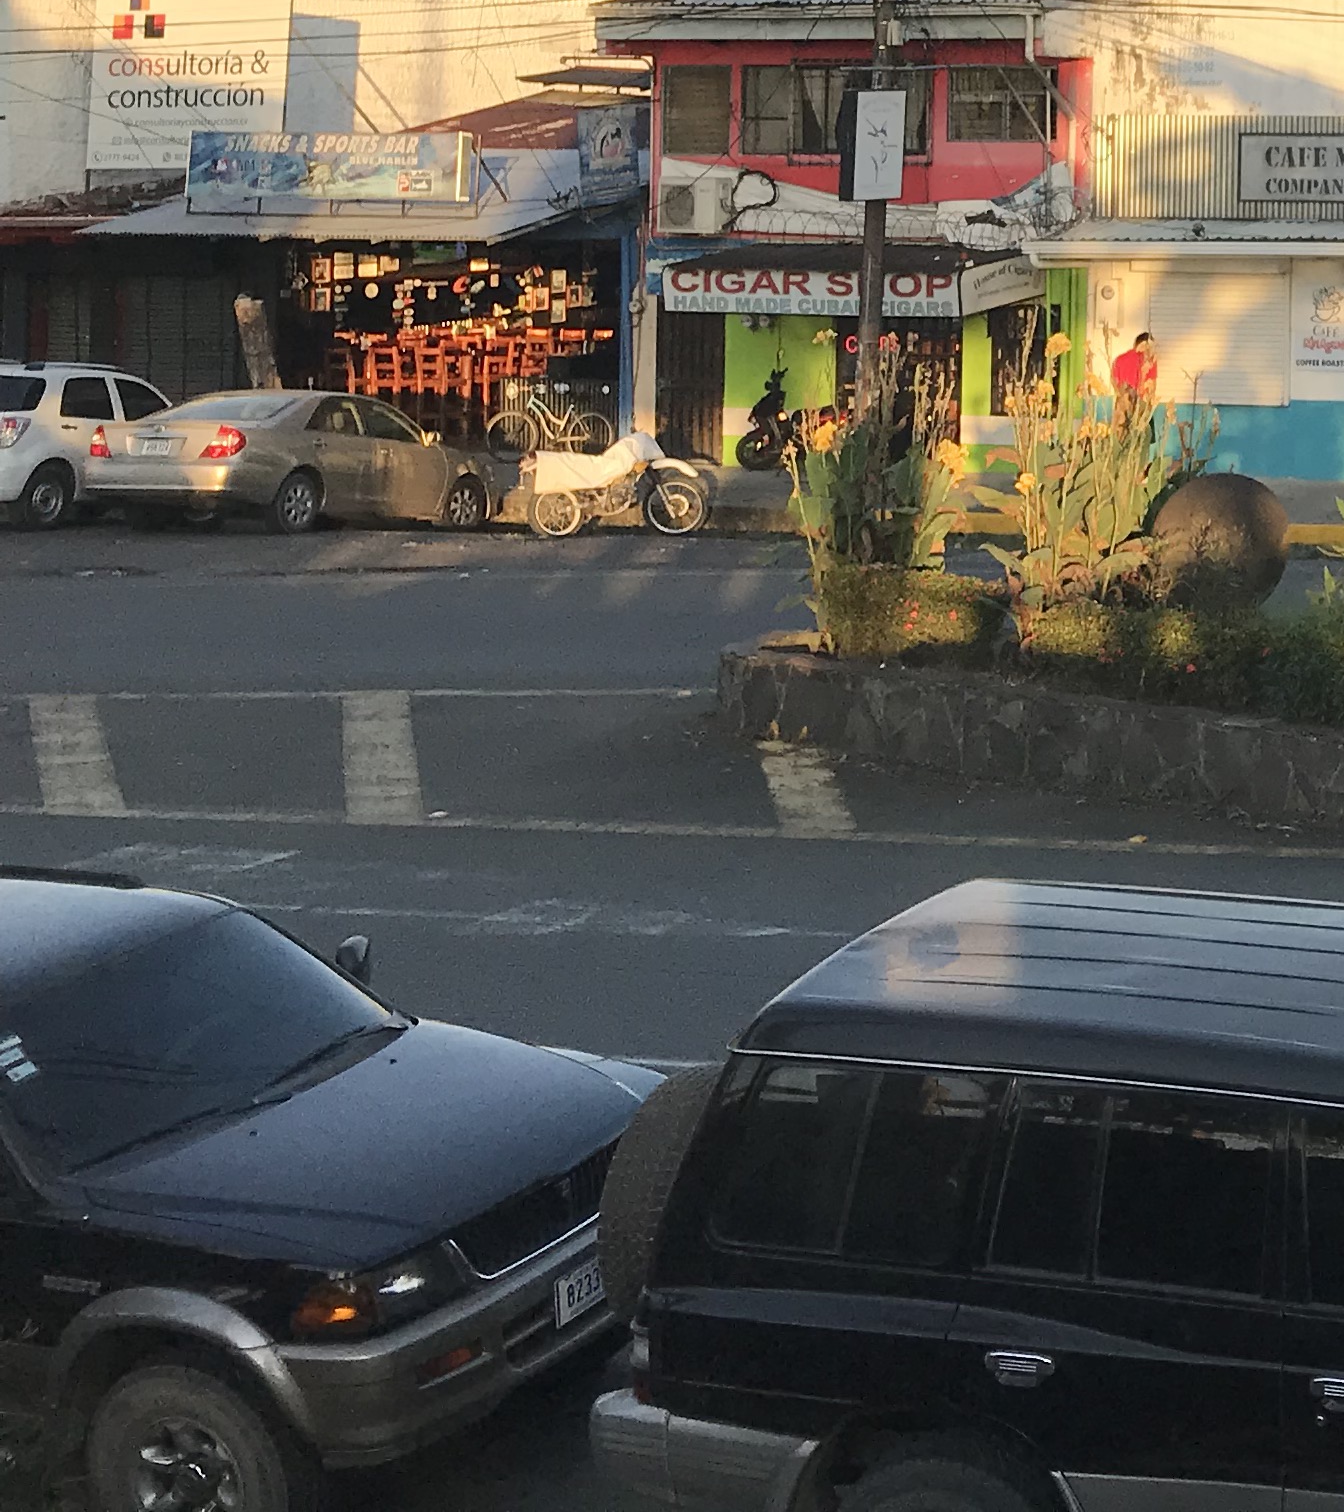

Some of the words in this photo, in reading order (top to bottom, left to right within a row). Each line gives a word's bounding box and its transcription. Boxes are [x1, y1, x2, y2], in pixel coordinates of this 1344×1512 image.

[108, 50, 243, 77] consultoría
[251, 49, 270, 75] &
[107, 82, 265, 108] construcción
[224, 134, 294, 153] SNACKS
[296, 134, 309, 153] &
[313, 134, 380, 154] SPORTS
[384, 135, 420, 154] BAR
[1264, 146, 1328, 168] CAFE
[670, 270, 812, 296] CIGAR
[826, 272, 952, 298] SOP
[673, 295, 729, 312] HAND
[735, 297, 792, 314] MADE
[1295, 358, 1320, 367] COFFEE
